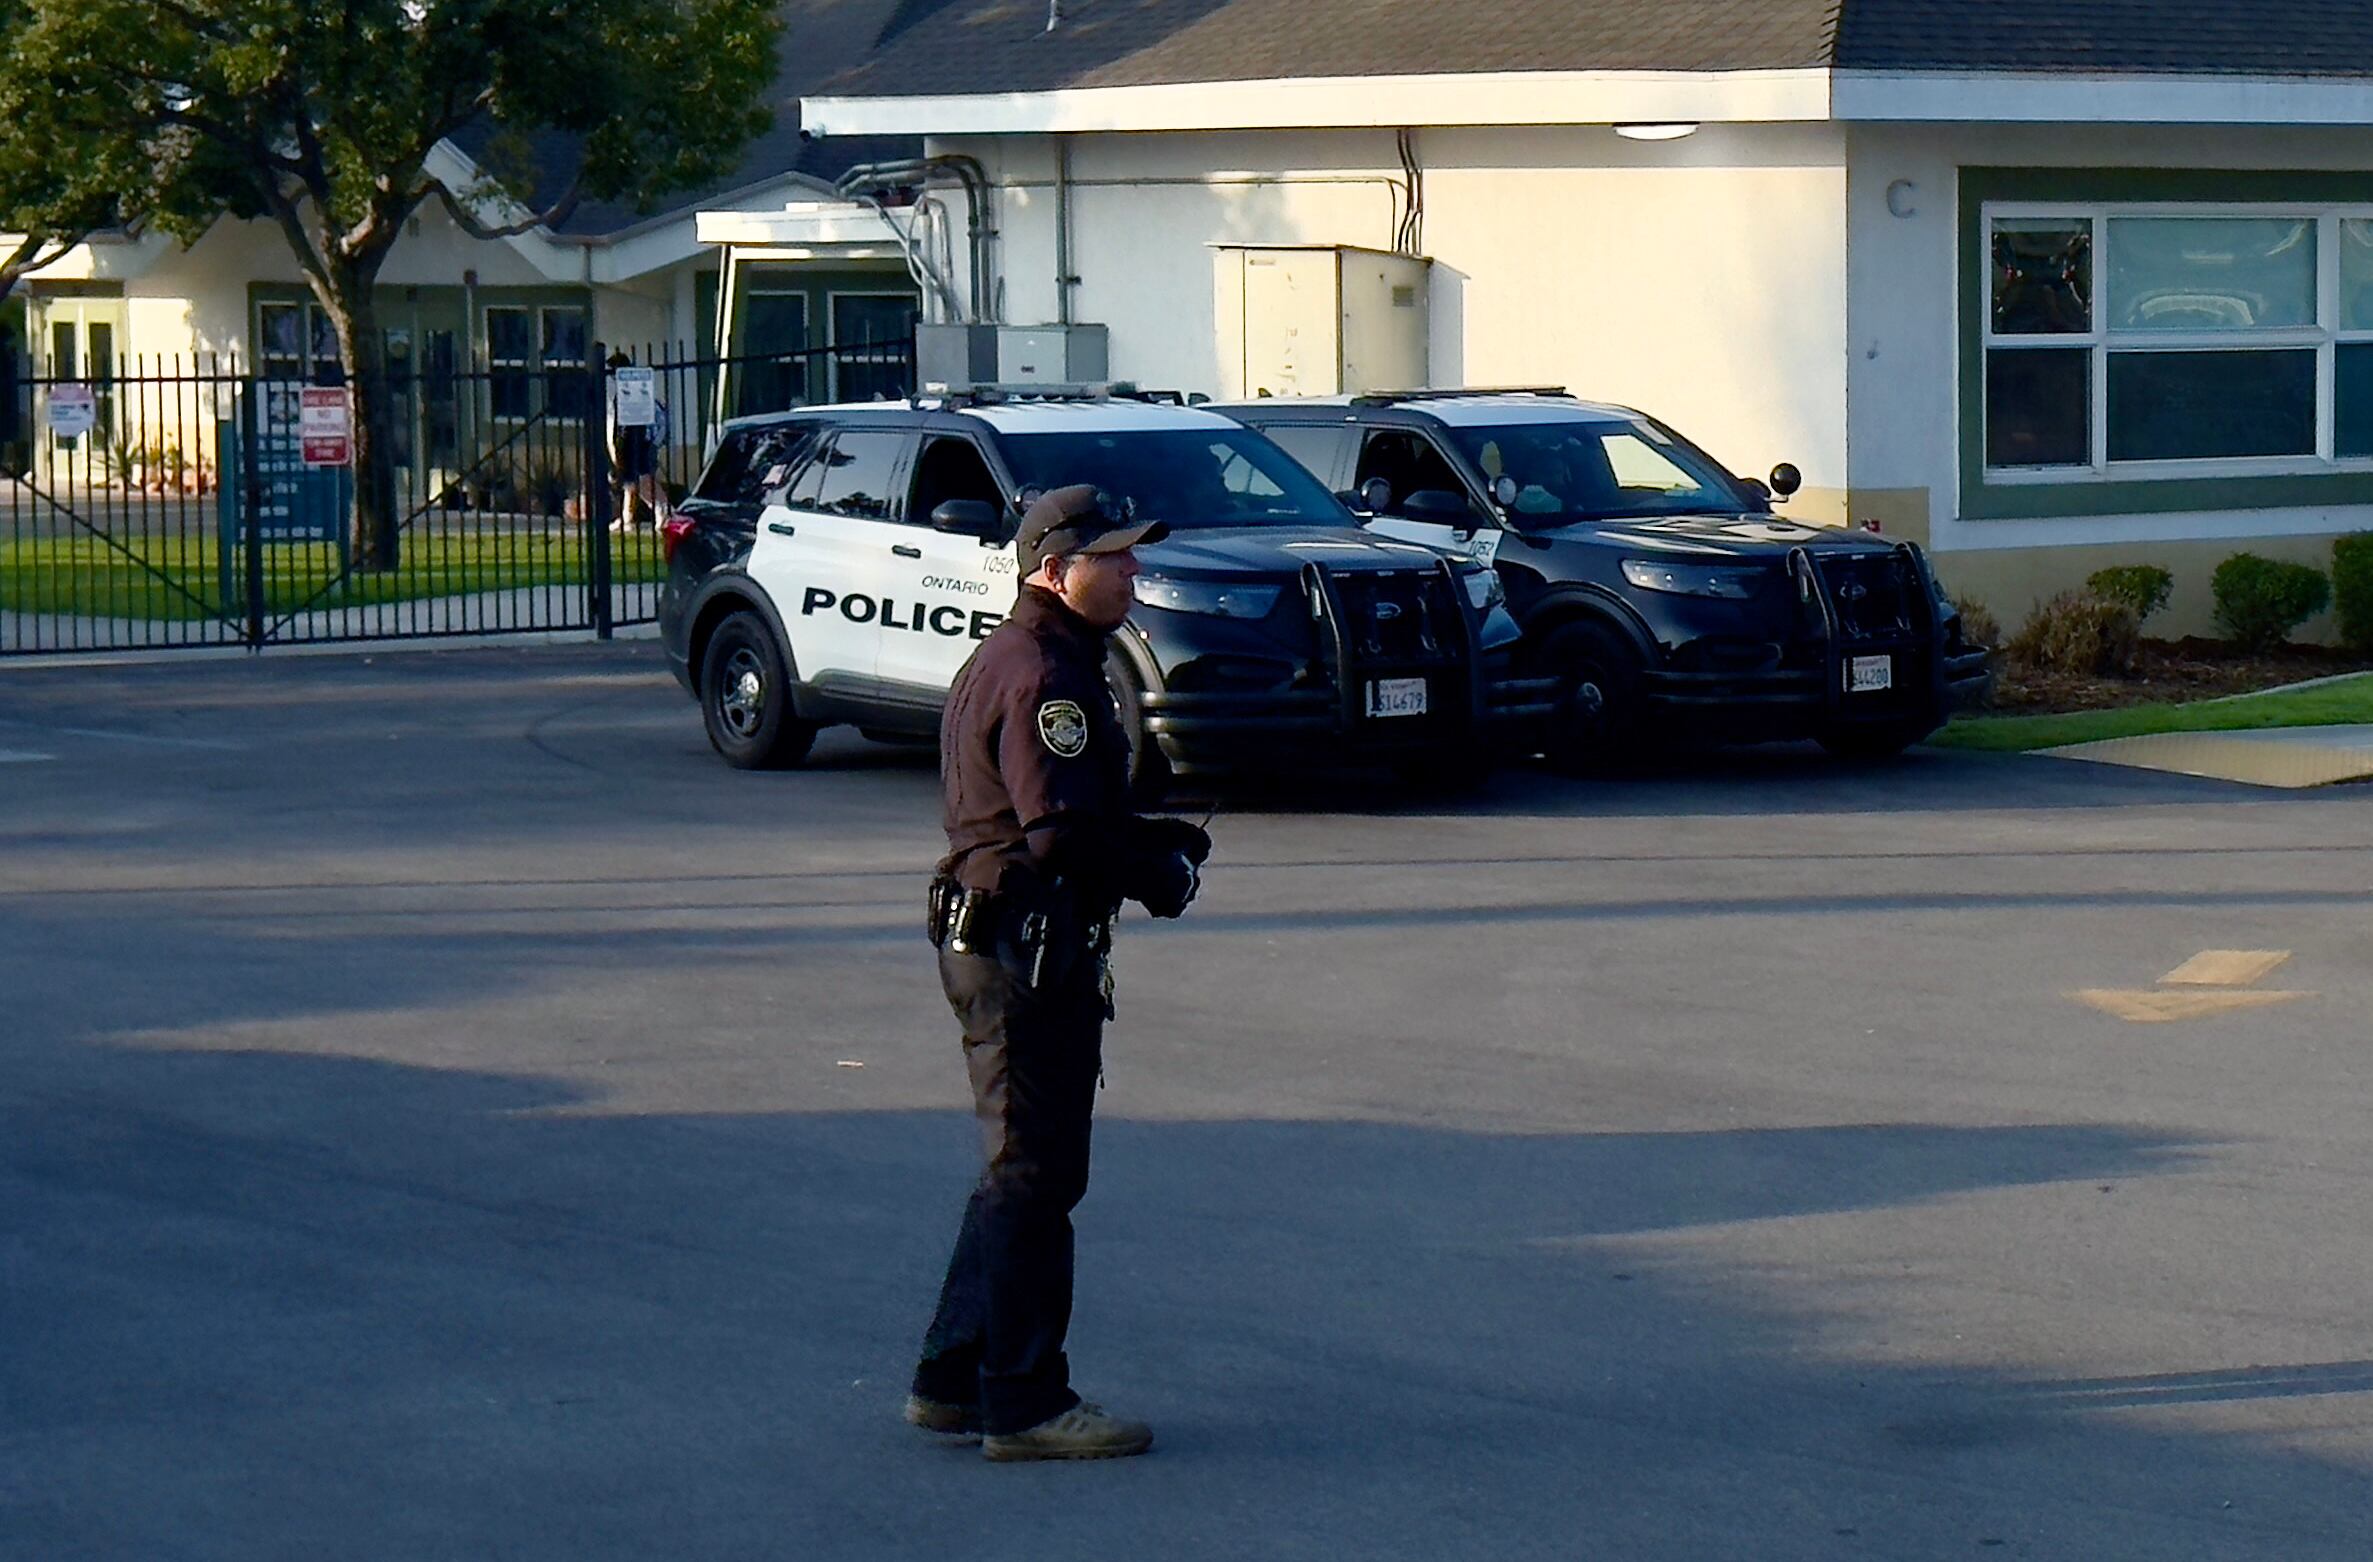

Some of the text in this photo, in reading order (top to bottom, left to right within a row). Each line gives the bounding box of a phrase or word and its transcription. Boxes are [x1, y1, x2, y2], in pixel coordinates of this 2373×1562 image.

[1886, 179, 1916, 219] C
[983, 556, 1015, 574] 1050
[922, 575, 989, 596] ONTARIO
[801, 586, 1004, 640] POLICE
